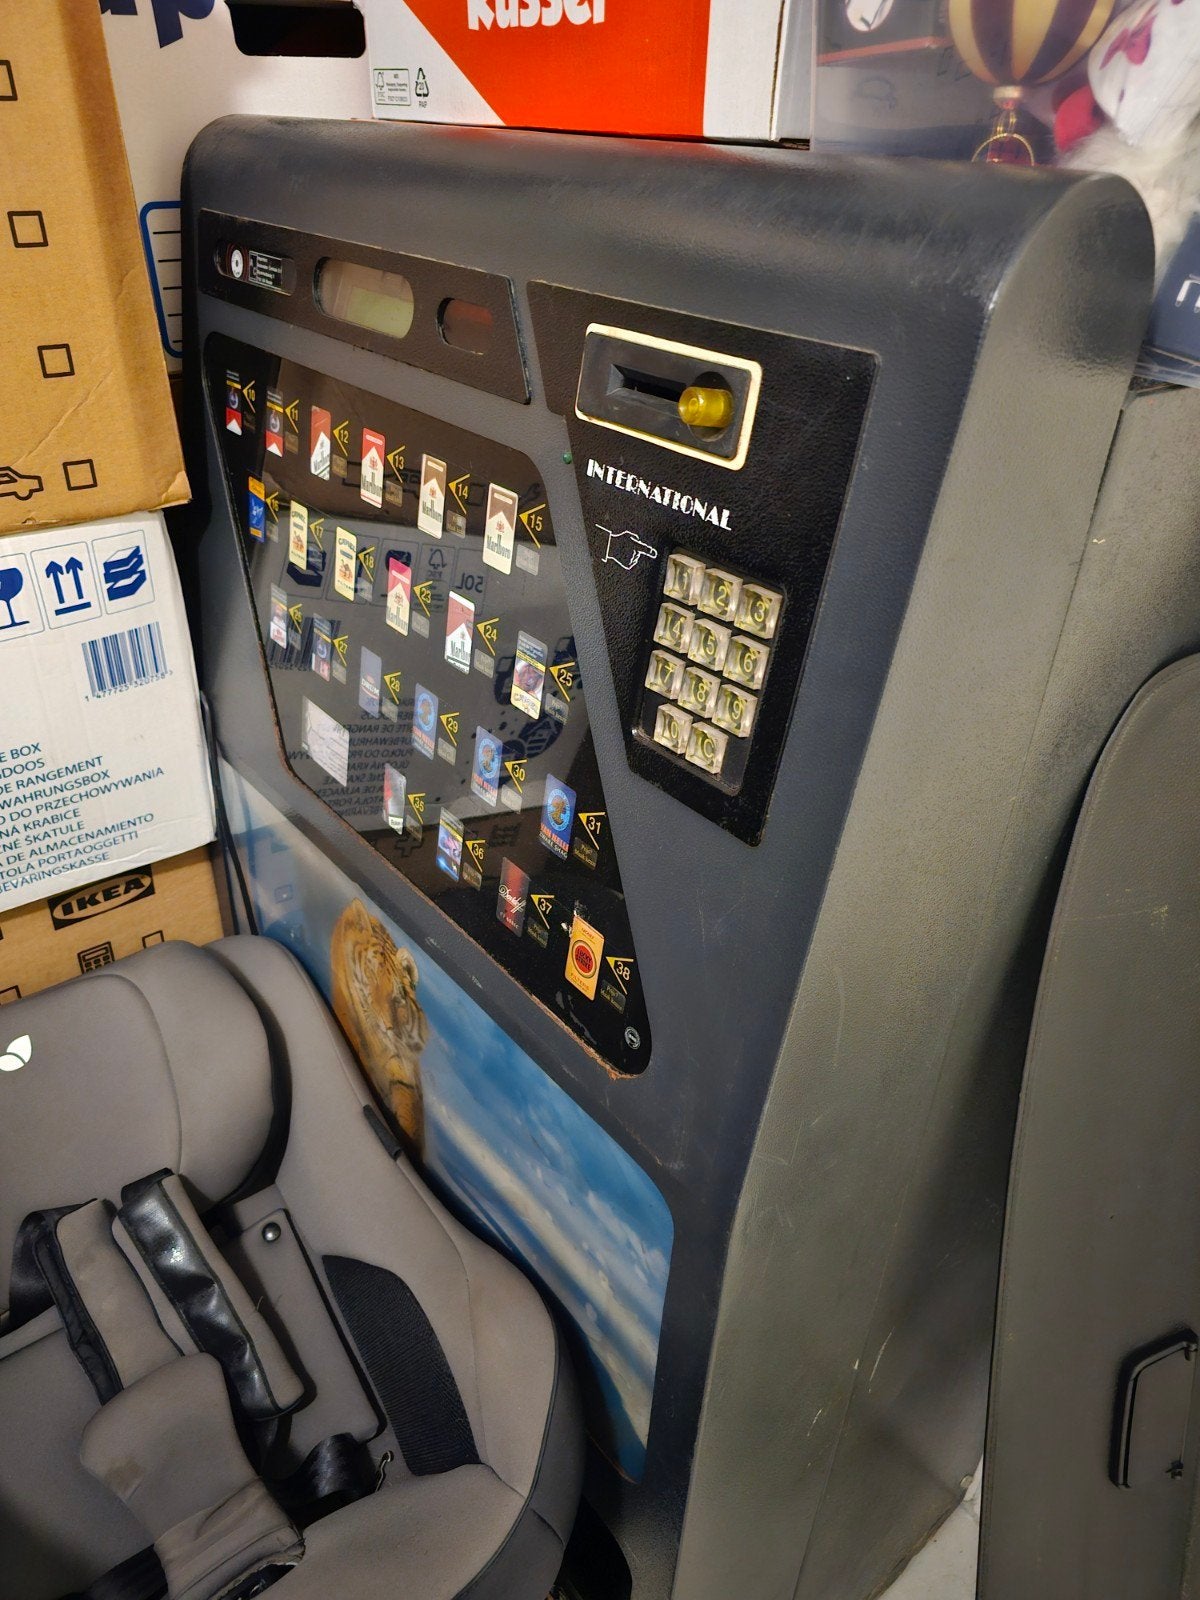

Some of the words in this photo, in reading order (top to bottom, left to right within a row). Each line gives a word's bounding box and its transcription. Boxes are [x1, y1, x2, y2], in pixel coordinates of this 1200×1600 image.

[291, 407, 299, 421] 11
[340, 429, 349, 444] 12
[394, 454, 404, 470] 13
[457, 483, 469, 500] 14
[586, 458, 732, 531] INTERNATIONAL
[530, 513, 543, 532] 15
[365, 555, 374, 569] 18
[485, 625, 497, 642] 24
[339, 641, 348, 654] 27
[559, 668, 574, 687] 25
[447, 717, 459, 733] 29
[10, 742, 42, 760] BOX
[0, 758, 45, 779] DOOS
[16, 756, 103, 790] RANGEMENT
[513, 764, 526, 781] 30
[9, 808, 32, 822] DO
[36, 767, 165, 814] PRZECHOWYWANIA
[414, 797, 425, 812] 35
[23, 807, 81, 832] KRABICE
[588, 816, 601, 835] 31
[0, 838, 22, 854] NÉ
[25, 820, 85, 846] ŠKATULE
[6, 852, 26, 865] DE
[29, 813, 154, 858] ALMACENAMIENTO
[38, 830, 139, 868] PORTAOGGETTI
[473, 843, 485, 860] 36
[61, 876, 146, 917] IKEA
[539, 898, 553, 915] 37
[616, 961, 631, 981] 38
